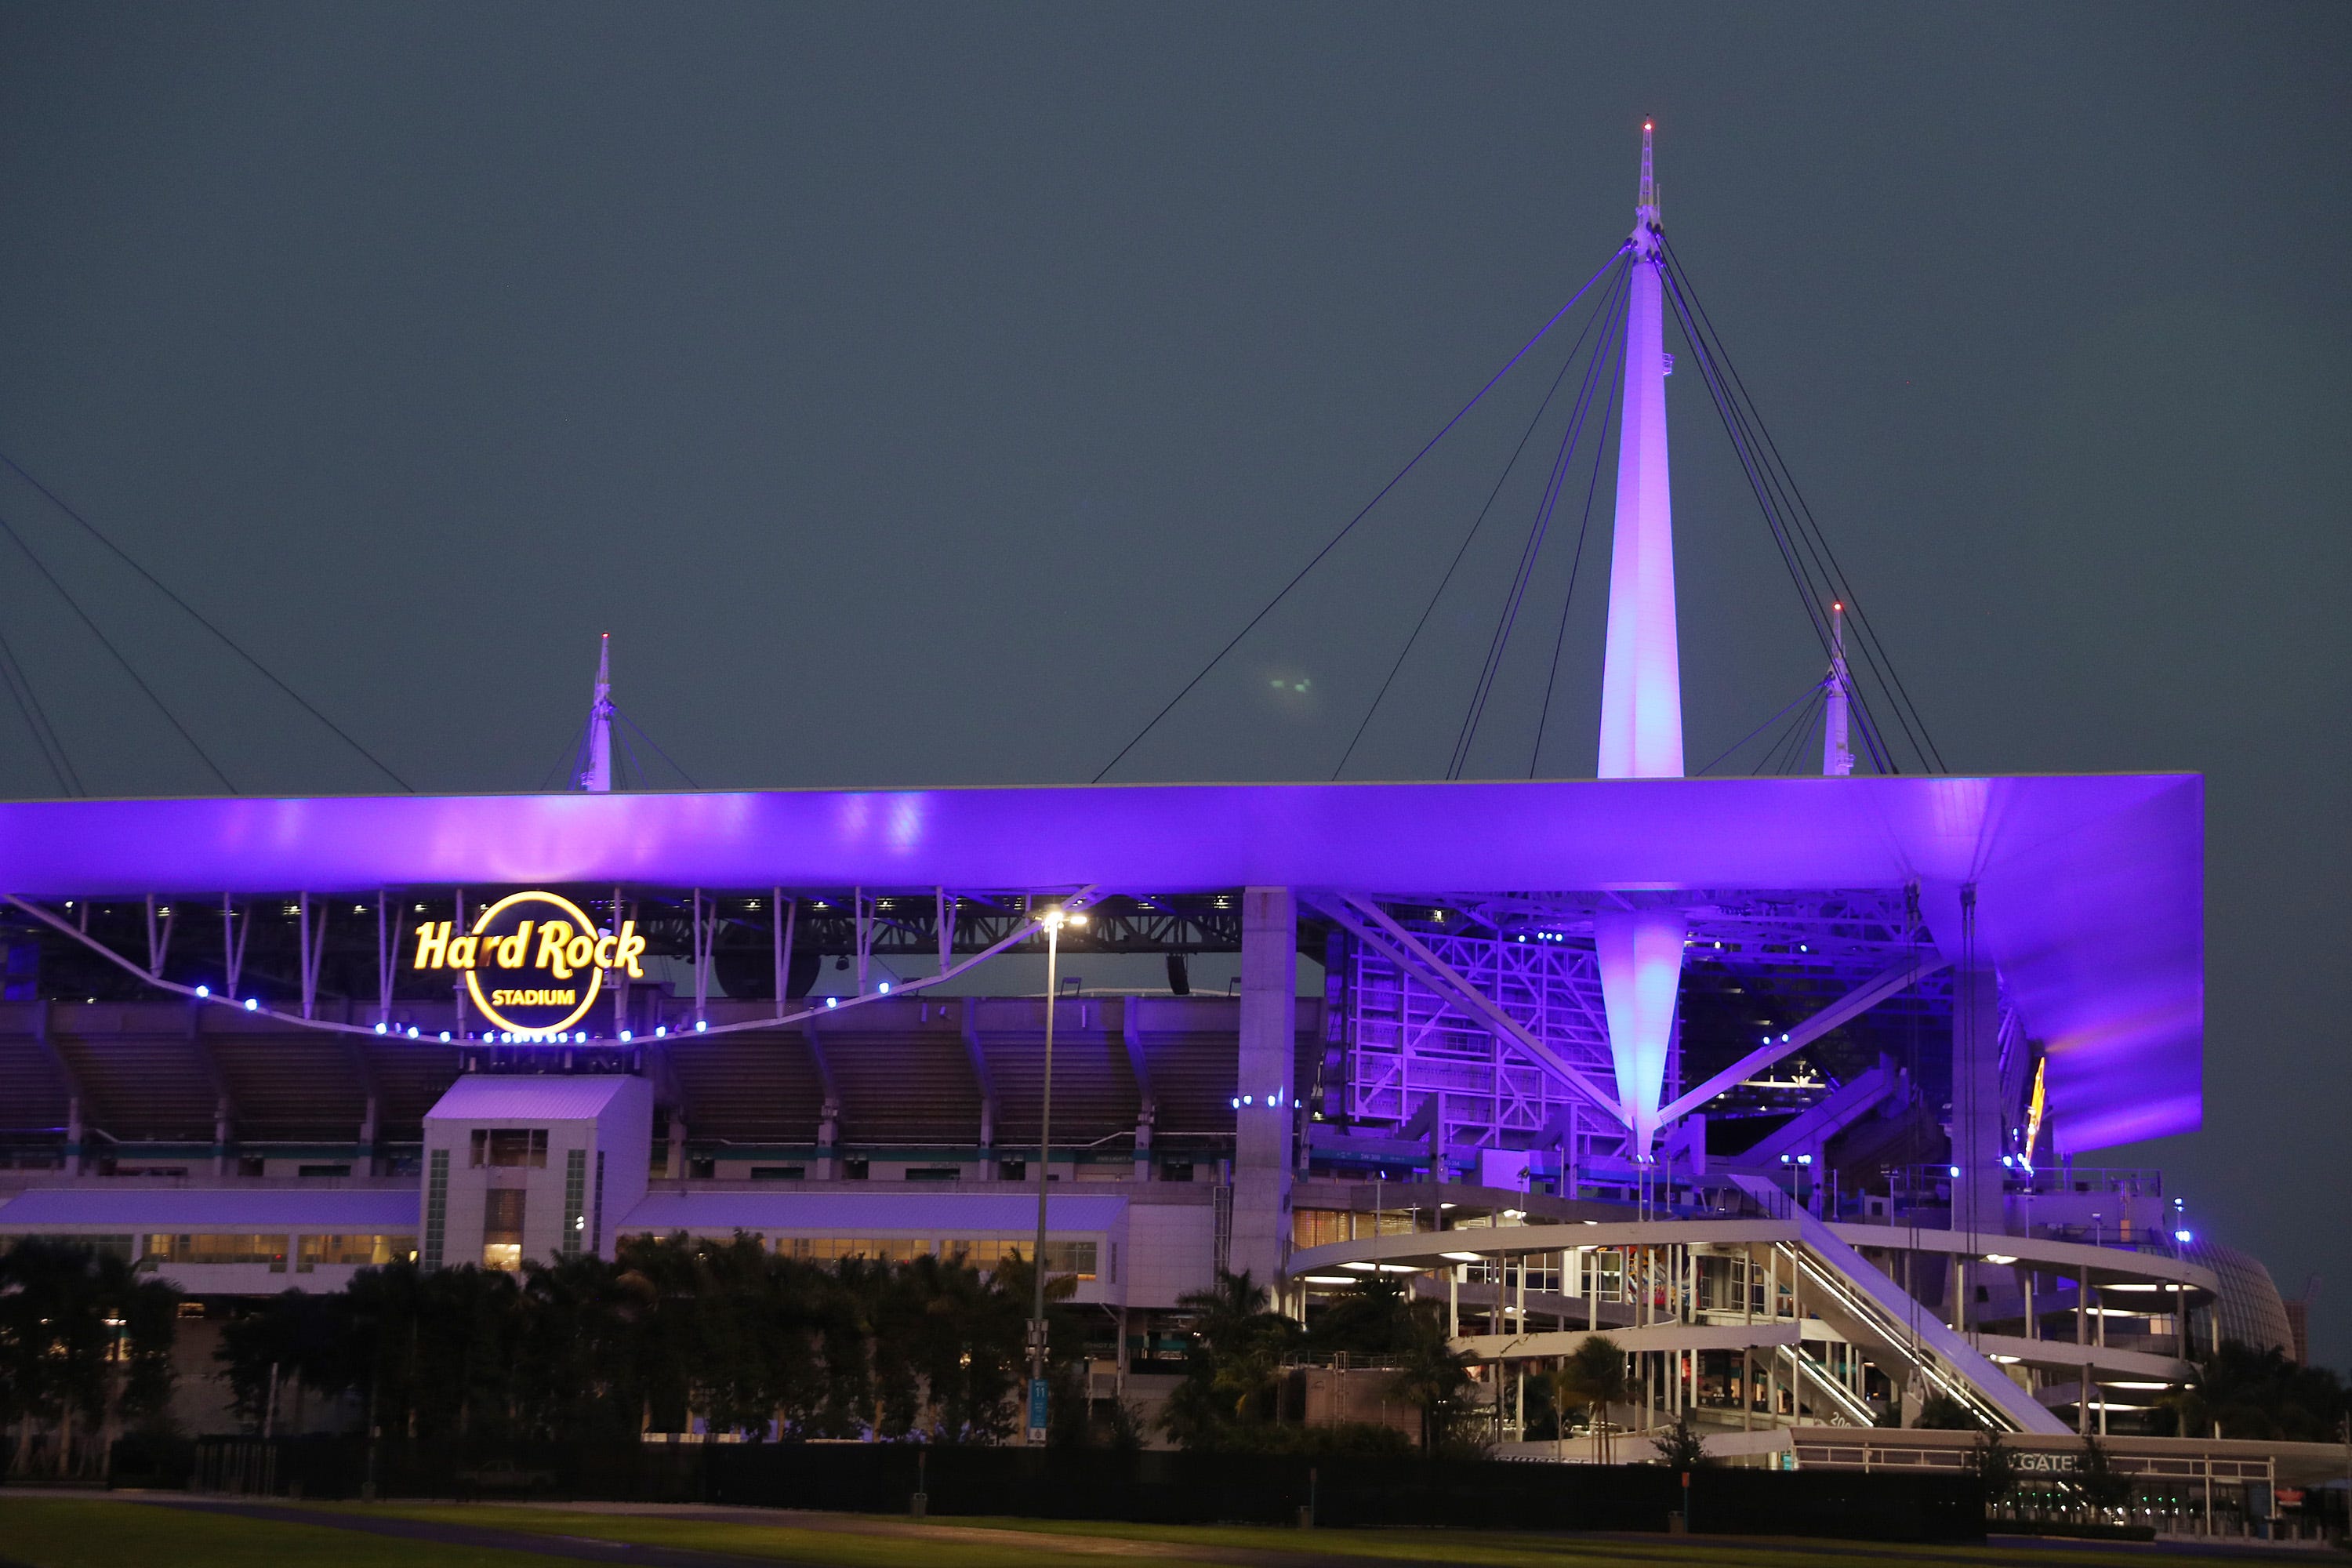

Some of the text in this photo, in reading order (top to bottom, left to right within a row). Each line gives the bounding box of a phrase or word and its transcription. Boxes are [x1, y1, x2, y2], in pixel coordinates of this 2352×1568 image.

[414, 920, 646, 979] Hard Rock
[492, 989, 575, 1006] STADIUM
[1036, 1386, 1045, 1398] 11
[2020, 1454, 2073, 1471] GATE
